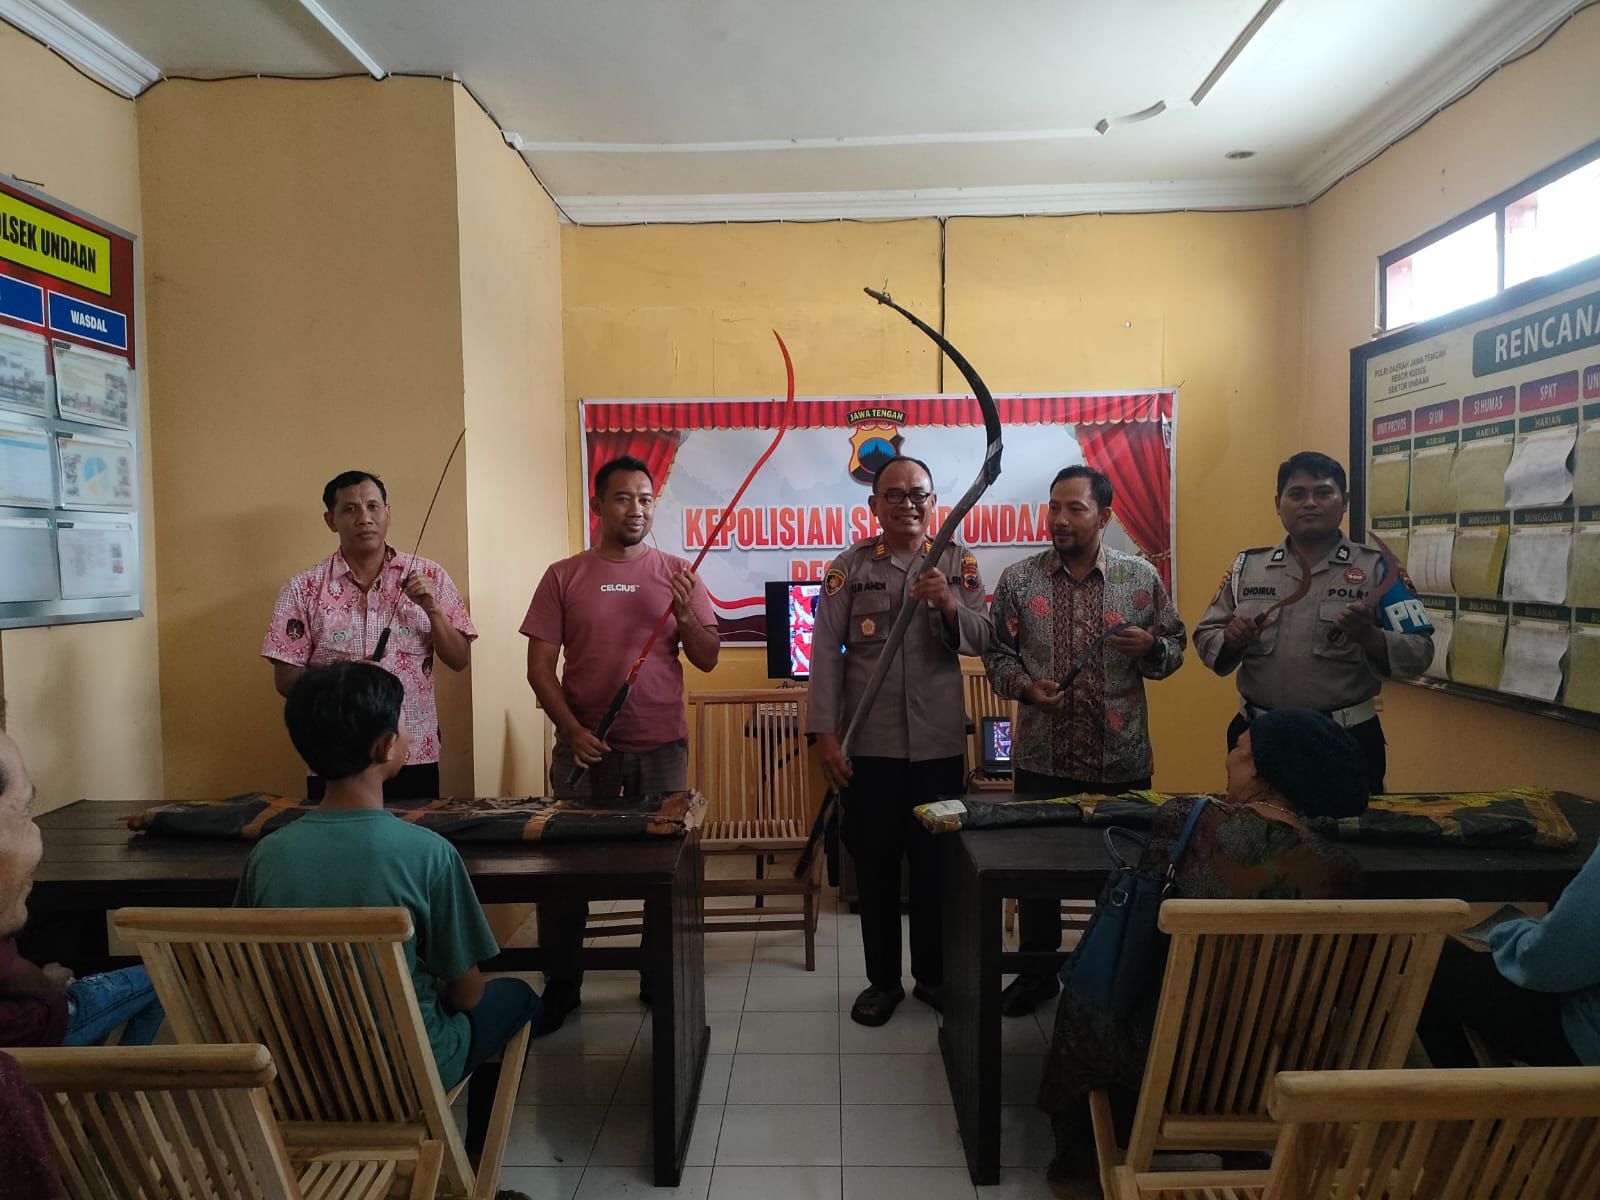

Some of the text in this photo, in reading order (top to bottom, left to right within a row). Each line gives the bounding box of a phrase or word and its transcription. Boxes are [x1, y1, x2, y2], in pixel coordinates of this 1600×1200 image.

[0, 212, 96, 274] LSEK UNDAAN
[70, 310, 108, 333] WASDAL
[1540, 383, 1558, 400] SPKT
[850, 409, 903, 422] JAWA TENGAH
[1535, 415, 1561, 429] HARIAN
[1476, 426, 1499, 438] HARIAN
[685, 506, 843, 547] KEPOLISIAN
[964, 503, 1053, 544] UNDAA
[600, 583, 636, 593] CELCIUS
[1242, 586, 1277, 597] CHOIRUL
[1328, 588, 1369, 600] POLRI
